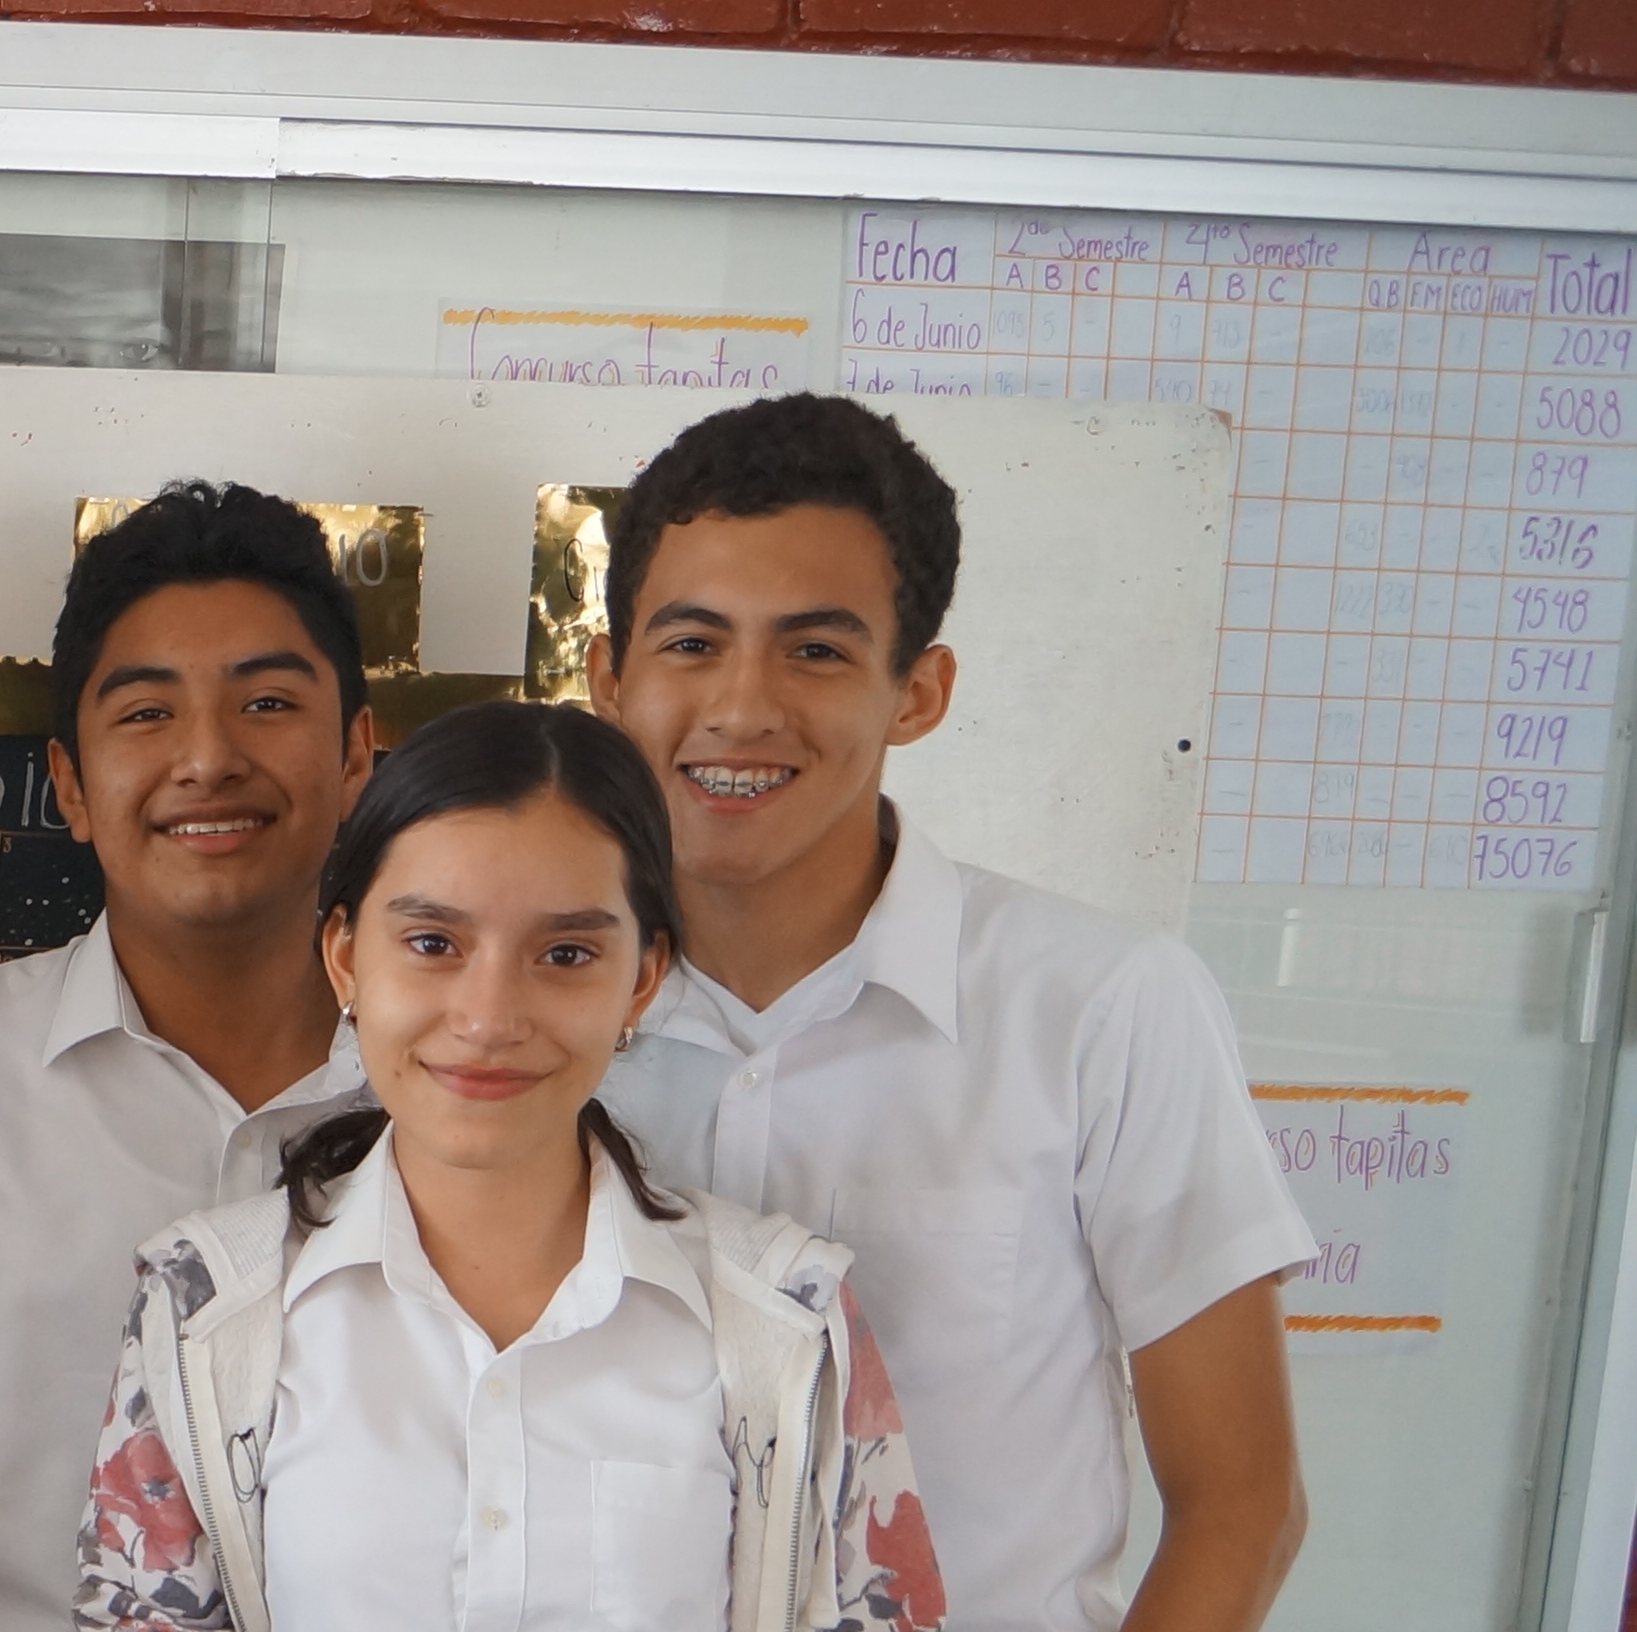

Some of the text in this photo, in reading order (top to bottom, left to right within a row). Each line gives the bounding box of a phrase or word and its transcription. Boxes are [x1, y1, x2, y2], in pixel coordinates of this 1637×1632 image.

[857, 212, 959, 283] Fecha
[1005, 263, 1024, 289] A
[1044, 264, 1063, 291] B
[1084, 265, 1100, 292] C
[1174, 271, 1193, 300] A
[1226, 272, 1247, 301] B
[1268, 275, 1285, 303] C
[1545, 248, 1633, 316] Total
[851, 288, 982, 351] 6 de Junio
[1551, 326, 1633, 372] 2029
[1535, 385, 1623, 439] 5088
[1525, 450, 1591, 499] 879
[1506, 647, 1595, 692] 5741
[1496, 712, 1570, 766] 9219
[1482, 775, 1568, 825] 8592
[1472, 834, 1580, 882] 75076
[1330, 1104, 1451, 1191] tapitas
